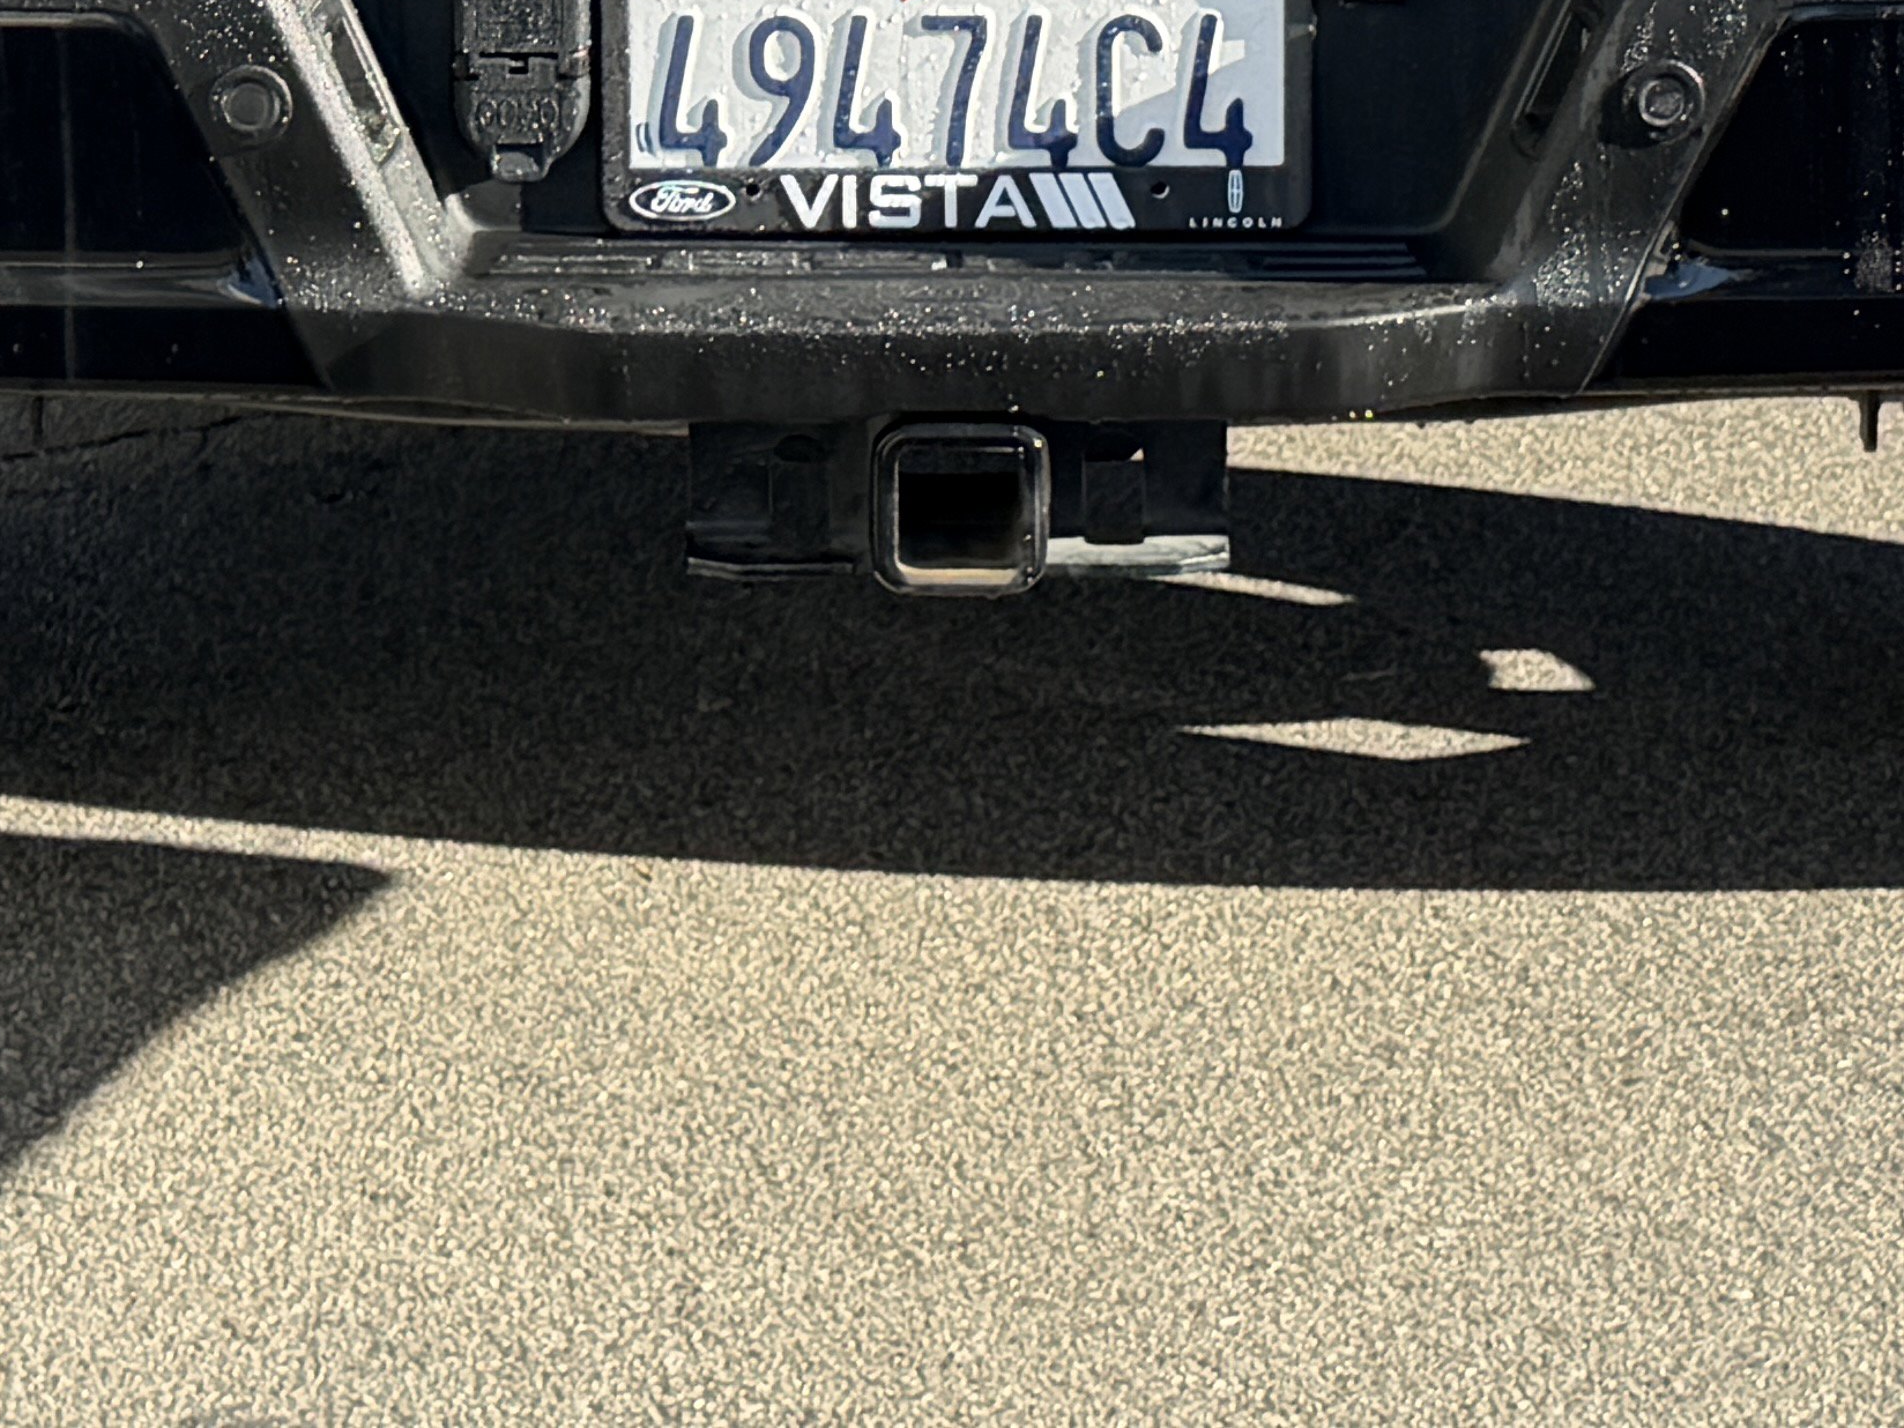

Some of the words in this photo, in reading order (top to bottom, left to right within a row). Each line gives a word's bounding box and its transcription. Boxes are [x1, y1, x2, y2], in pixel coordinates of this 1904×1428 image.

[658, 14, 1253, 168] 49474C4
[649, 186, 716, 213] Ford
[779, 173, 1037, 229] VISTA
[1188, 216, 1283, 229] LINCOLN
